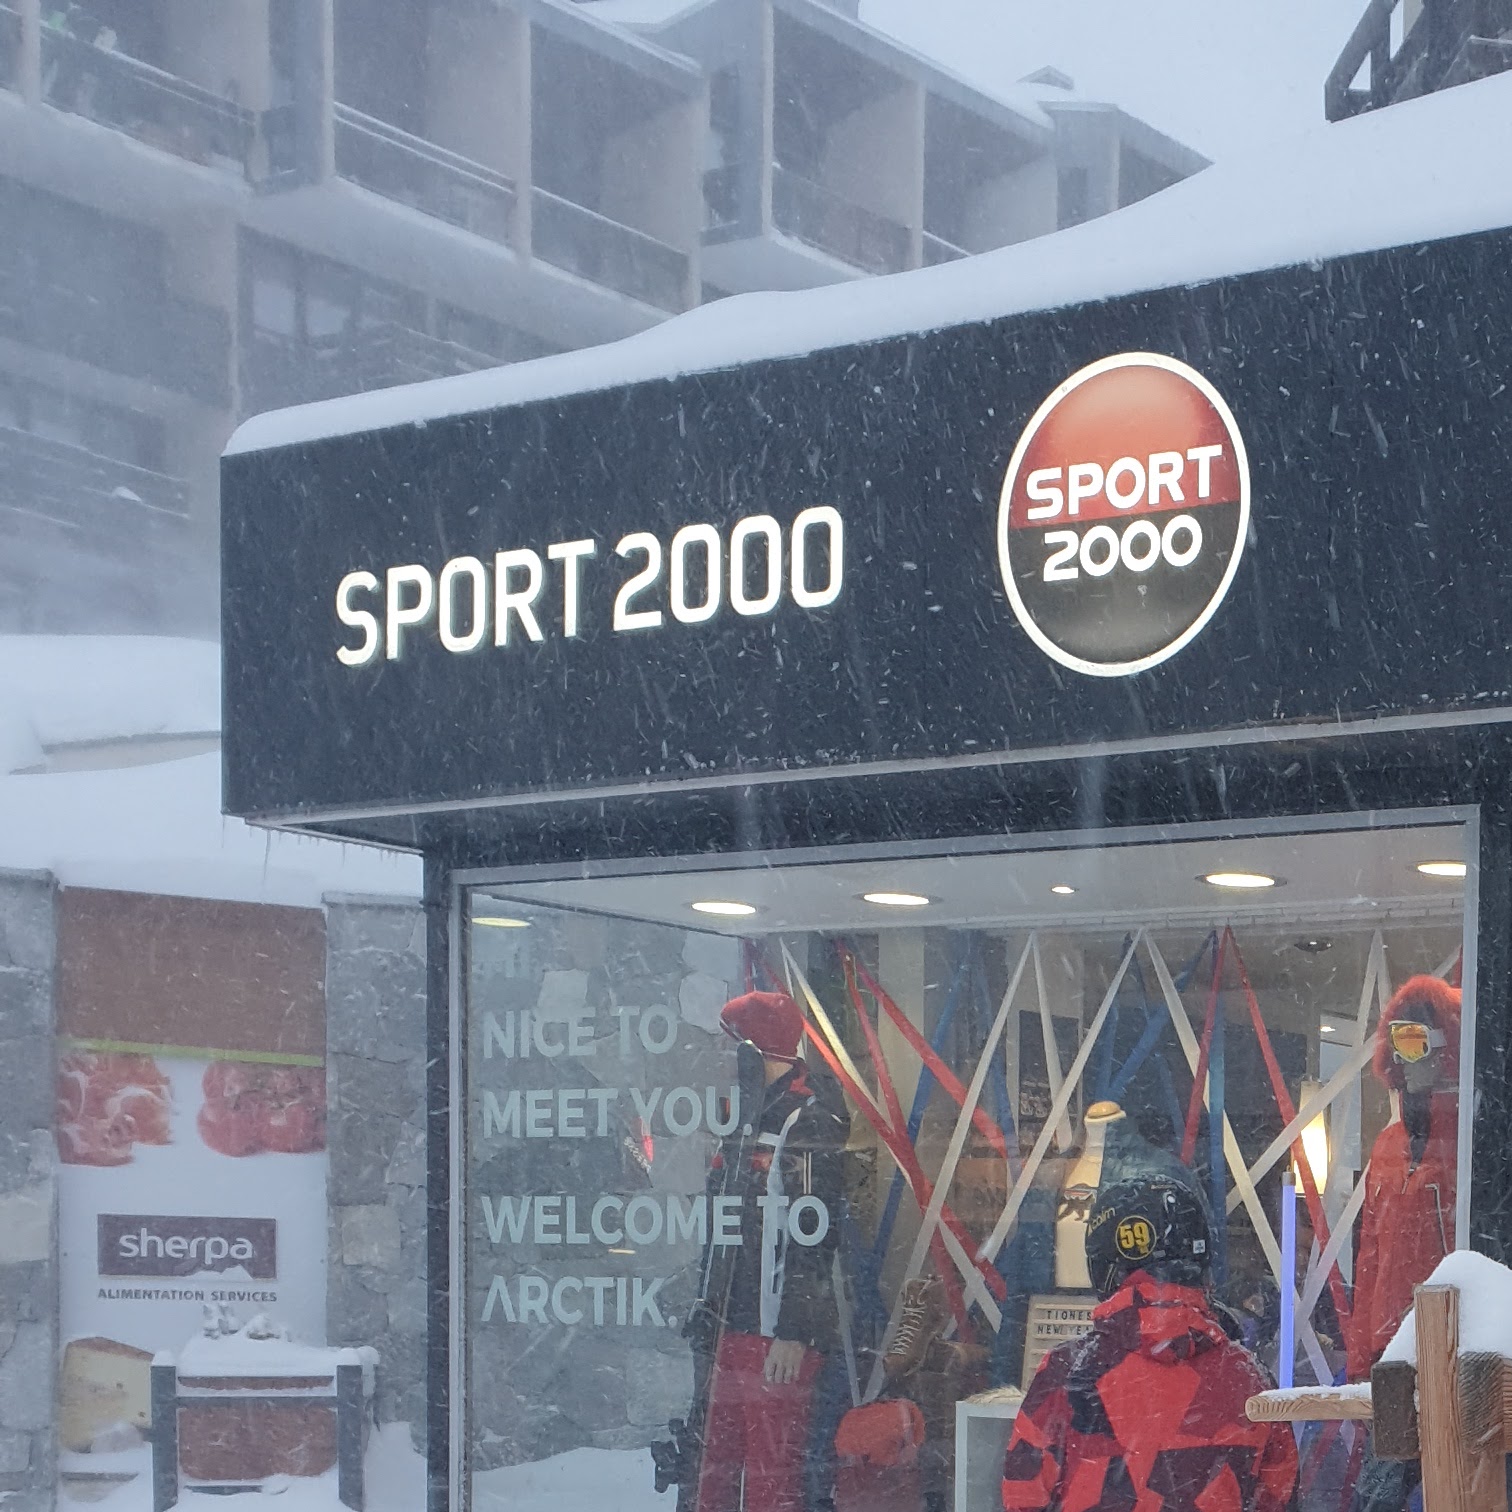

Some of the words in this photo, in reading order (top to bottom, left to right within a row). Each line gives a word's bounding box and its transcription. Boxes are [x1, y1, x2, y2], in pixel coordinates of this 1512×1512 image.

[1026, 444, 1223, 522] SPORT
[1042, 514, 1204, 583] 2000
[335, 538, 595, 668] SPORT
[613, 506, 844, 632] 2000
[481, 1006, 596, 1059] NICE
[611, 1003, 680, 1056] TO
[482, 1087, 619, 1140] MEET
[628, 1084, 754, 1138] YOU.
[118, 1227, 254, 1265] sherpa
[481, 1194, 744, 1247] WELCOME
[756, 1194, 831, 1247] TO
[1119, 1221, 1150, 1254] 59
[97, 1287, 205, 1301] ALIMENTATION
[210, 1290, 278, 1302] SERVICES
[480, 1274, 679, 1329] ARCTIK.
[1037, 1325, 1063, 1335] NEW
